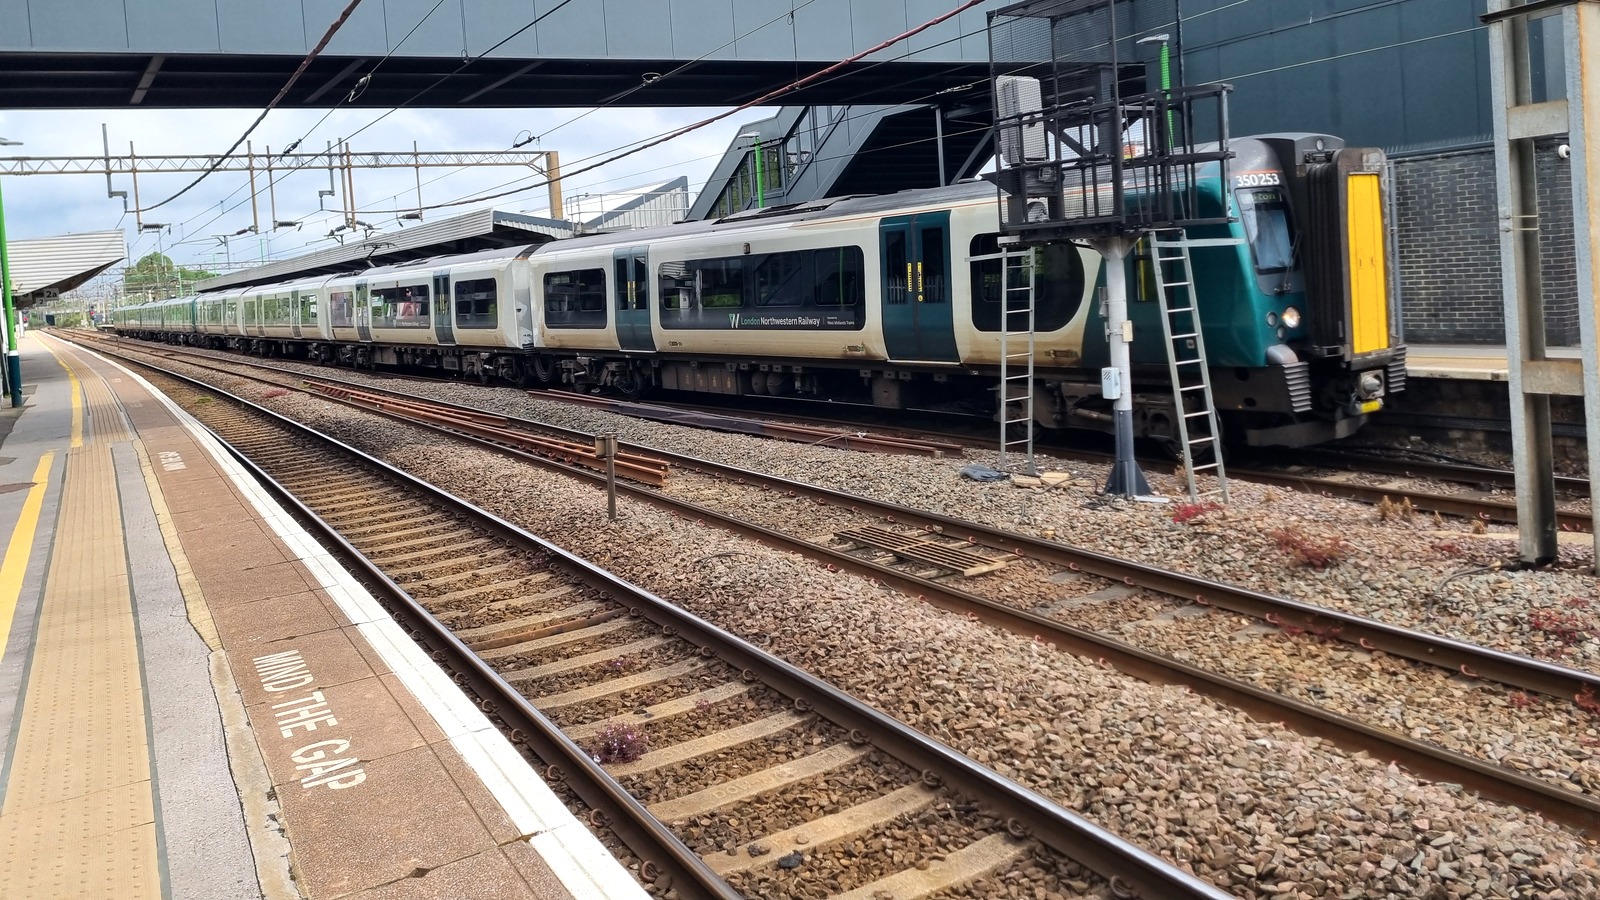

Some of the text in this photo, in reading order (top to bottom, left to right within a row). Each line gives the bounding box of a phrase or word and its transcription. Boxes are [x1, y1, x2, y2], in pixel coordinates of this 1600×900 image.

[1235, 173, 1280, 187] 350 253
[46, 290, 57, 298] 2a
[741, 317, 761, 326] London
[760, 316, 798, 326] Northwestern
[798, 316, 820, 327] Railway
[252, 649, 367, 790] MIND THE GAP
